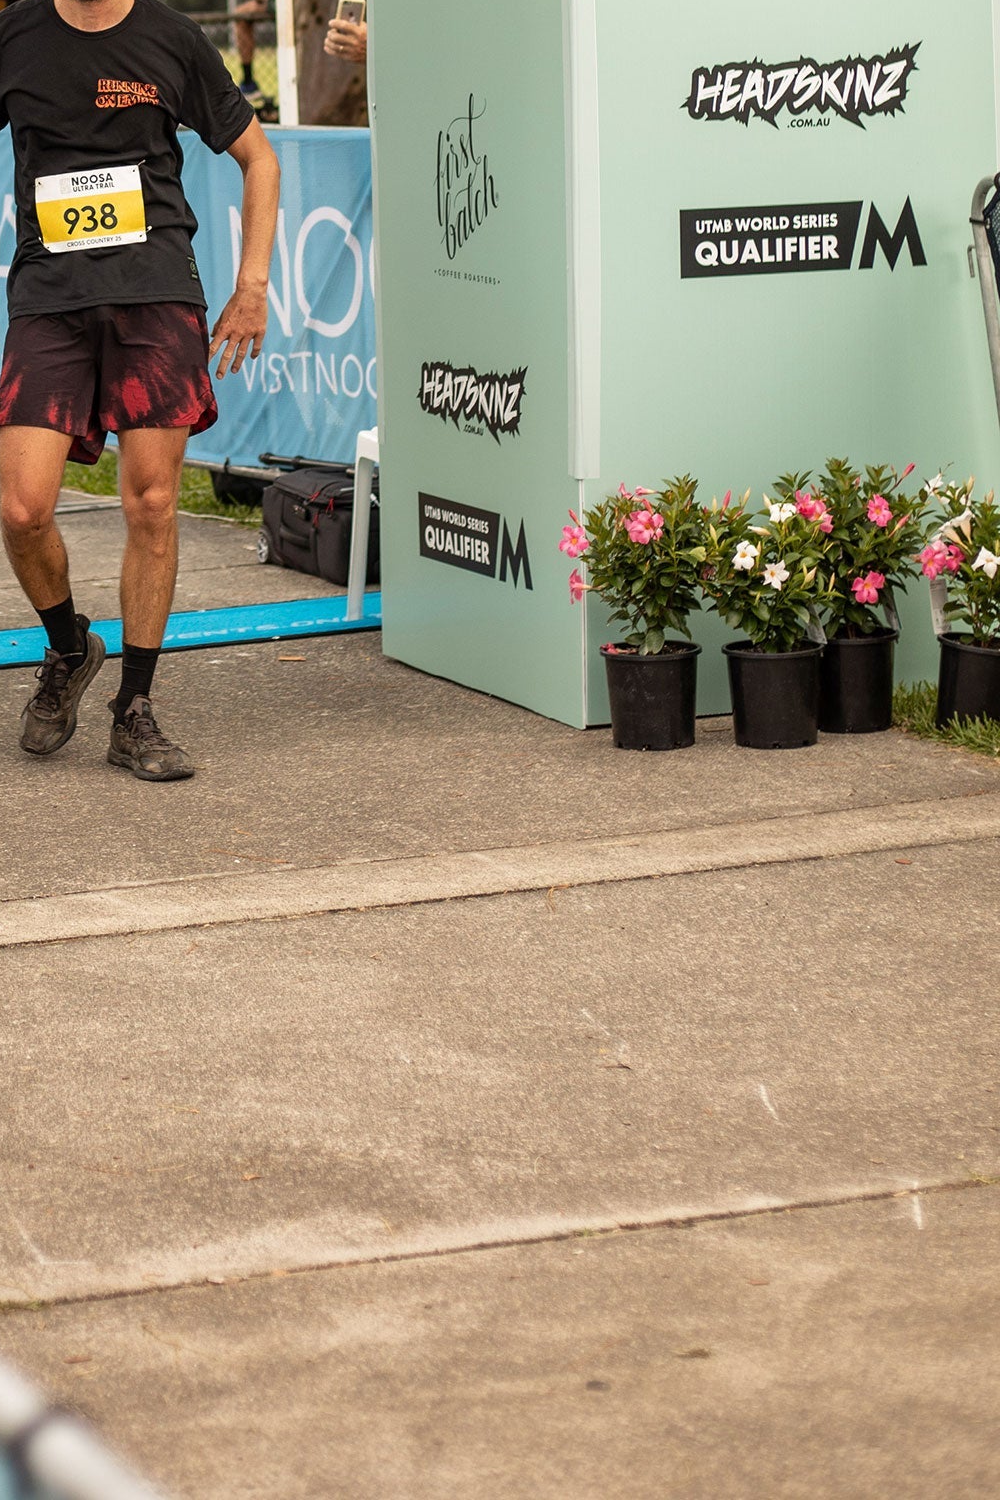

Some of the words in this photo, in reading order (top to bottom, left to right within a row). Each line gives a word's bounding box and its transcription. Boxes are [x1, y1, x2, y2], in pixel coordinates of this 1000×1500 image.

[98, 79, 158, 98] RUNNING
[694, 59, 907, 115] HEADSKINZ
[787, 117, 831, 129] .COM.AU
[433, 93, 487, 226] first
[71, 172, 114, 186] NOOSA
[72, 184, 94, 192] ULTRA
[96, 182, 115, 190] TRAIL
[63, 203, 118, 235] 938
[441, 155, 498, 260] batch
[695, 219, 732, 234] UTMB
[735, 216, 790, 232] WORLD
[793, 213, 838, 230] SERIES
[66, 240, 86, 248] CROSS
[87, 237, 113, 245] COUNTRY
[694, 234, 840, 267] QUALIFIER
[438, 269, 461, 280] COFFEE
[464, 273, 496, 286] ROASTERS
[423, 368, 521, 426] HEADSKINZ
[424, 504, 441, 520] UTMB
[442, 507, 467, 528] WORLD
[467, 516, 489, 534] SERIES
[425, 524, 490, 566] QUALIFIER
